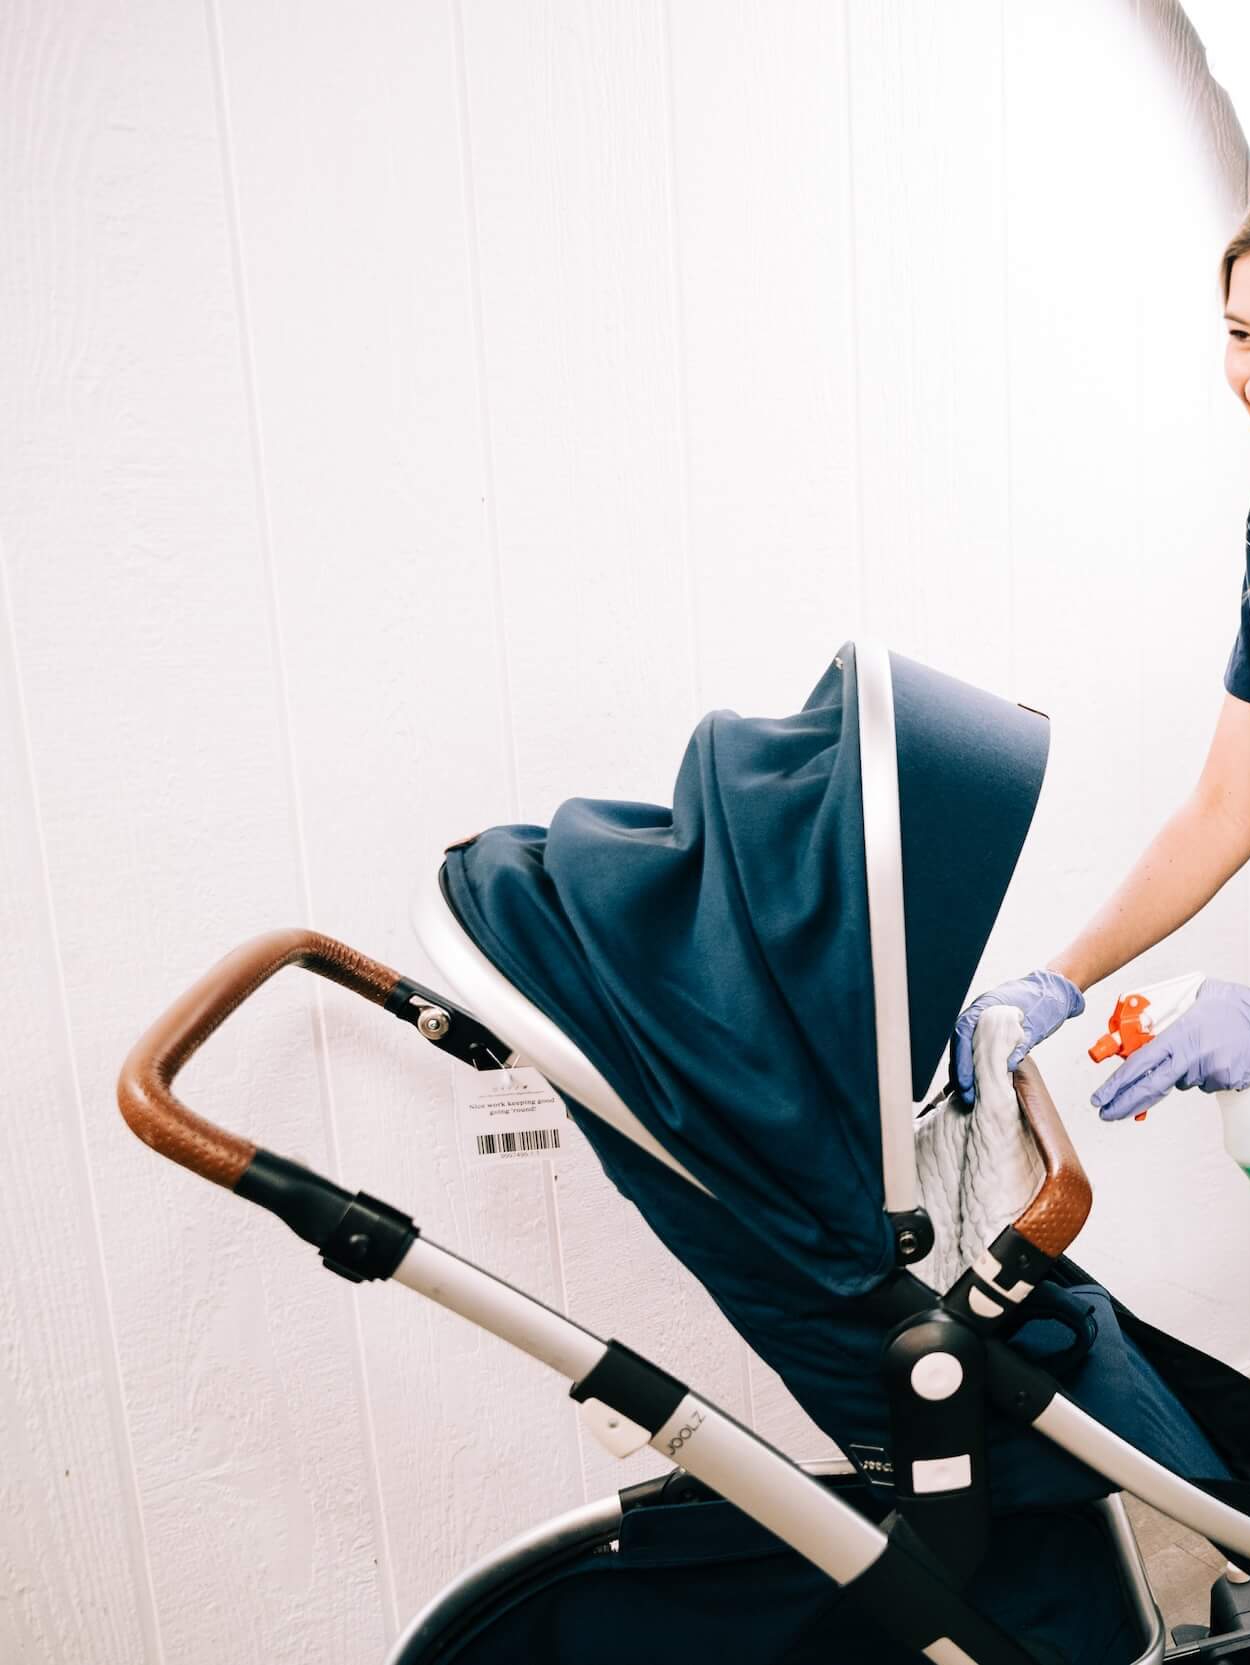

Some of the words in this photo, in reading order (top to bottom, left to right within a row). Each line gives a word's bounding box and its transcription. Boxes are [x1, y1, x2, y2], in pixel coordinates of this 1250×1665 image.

[507, 1099, 536, 1107] keeping
[537, 1097, 555, 1105] good
[489, 1108, 510, 1116] going
[667, 1410, 706, 1456] JOOLZ
